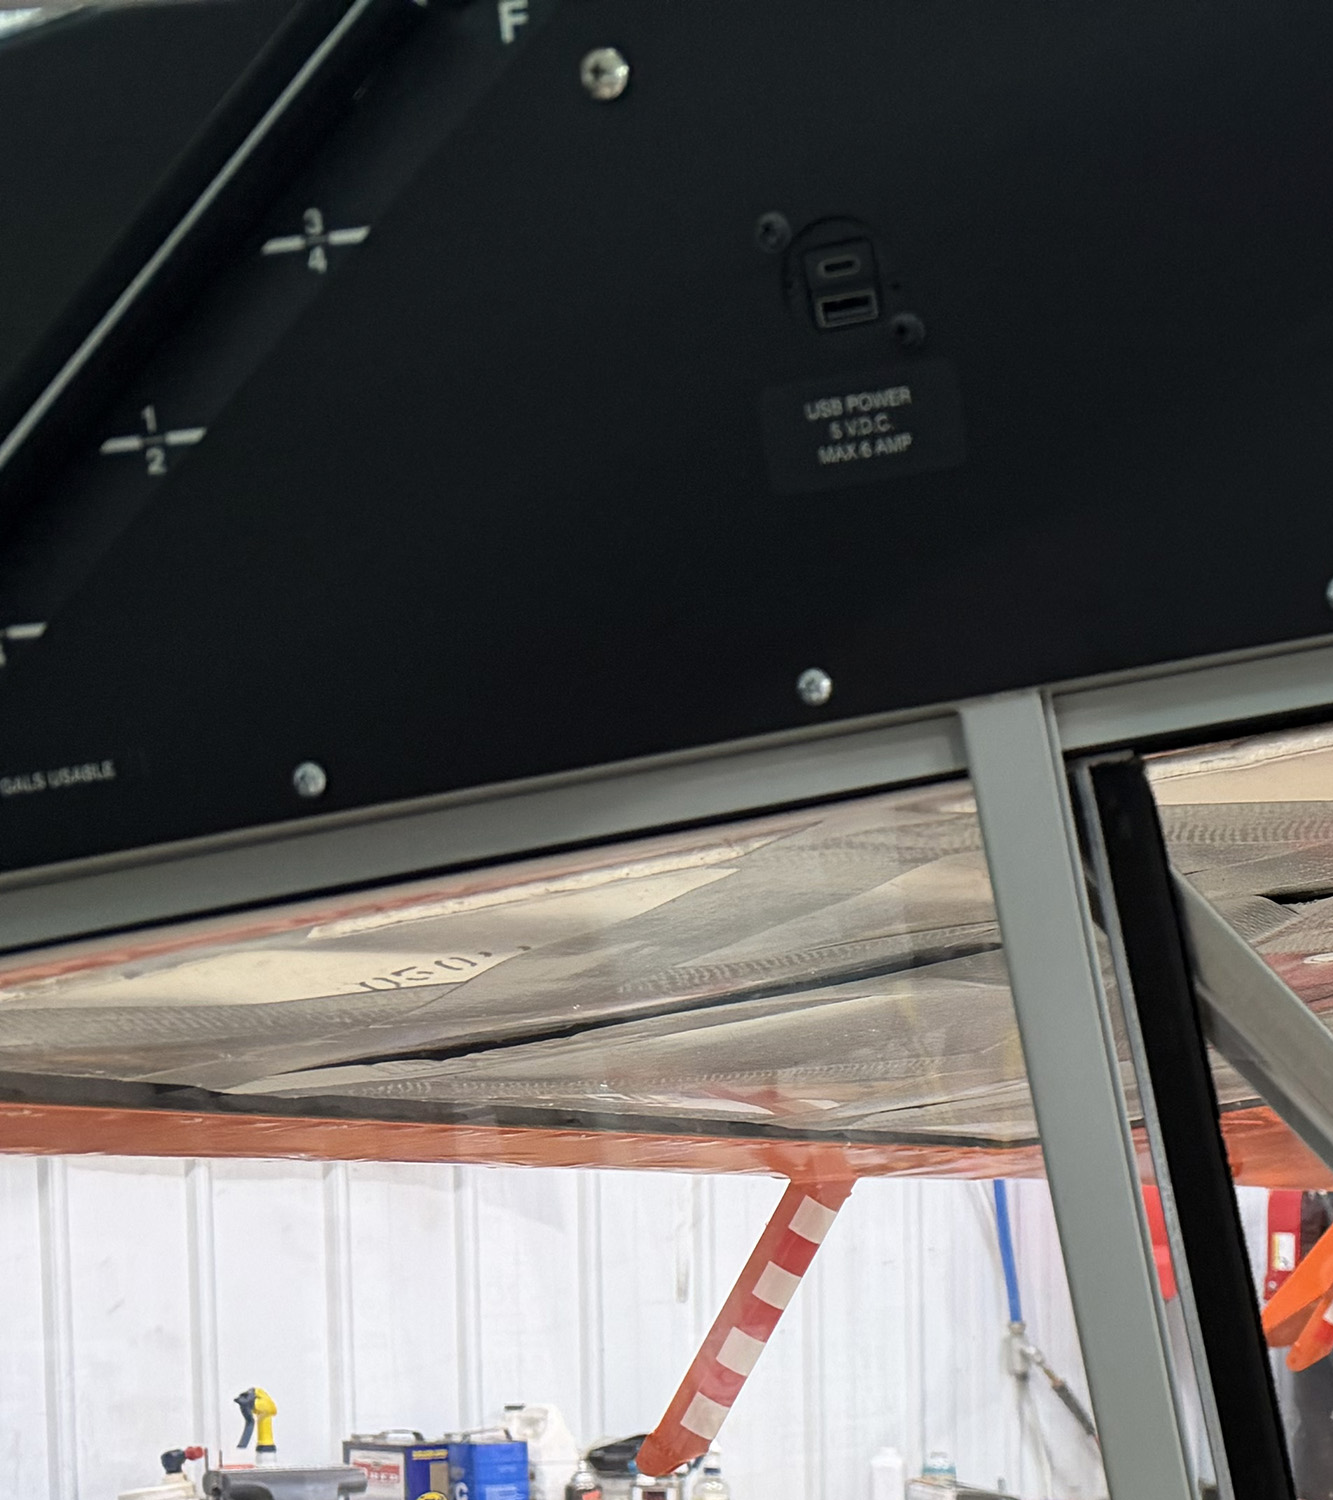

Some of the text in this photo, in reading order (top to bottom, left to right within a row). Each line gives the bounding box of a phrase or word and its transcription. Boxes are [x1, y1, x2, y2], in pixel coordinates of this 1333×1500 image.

[498, 1, 528, 43] F
[304, 208, 323, 235] 3
[309, 246, 328, 274] 4
[805, 386, 912, 421] USB POWER
[142, 405, 157, 431] 1
[829, 420, 843, 440] 5
[146, 448, 167, 475] 2
[818, 433, 913, 465] MAX 6 AMP
[0, 759, 116, 797] GALS USABLE
